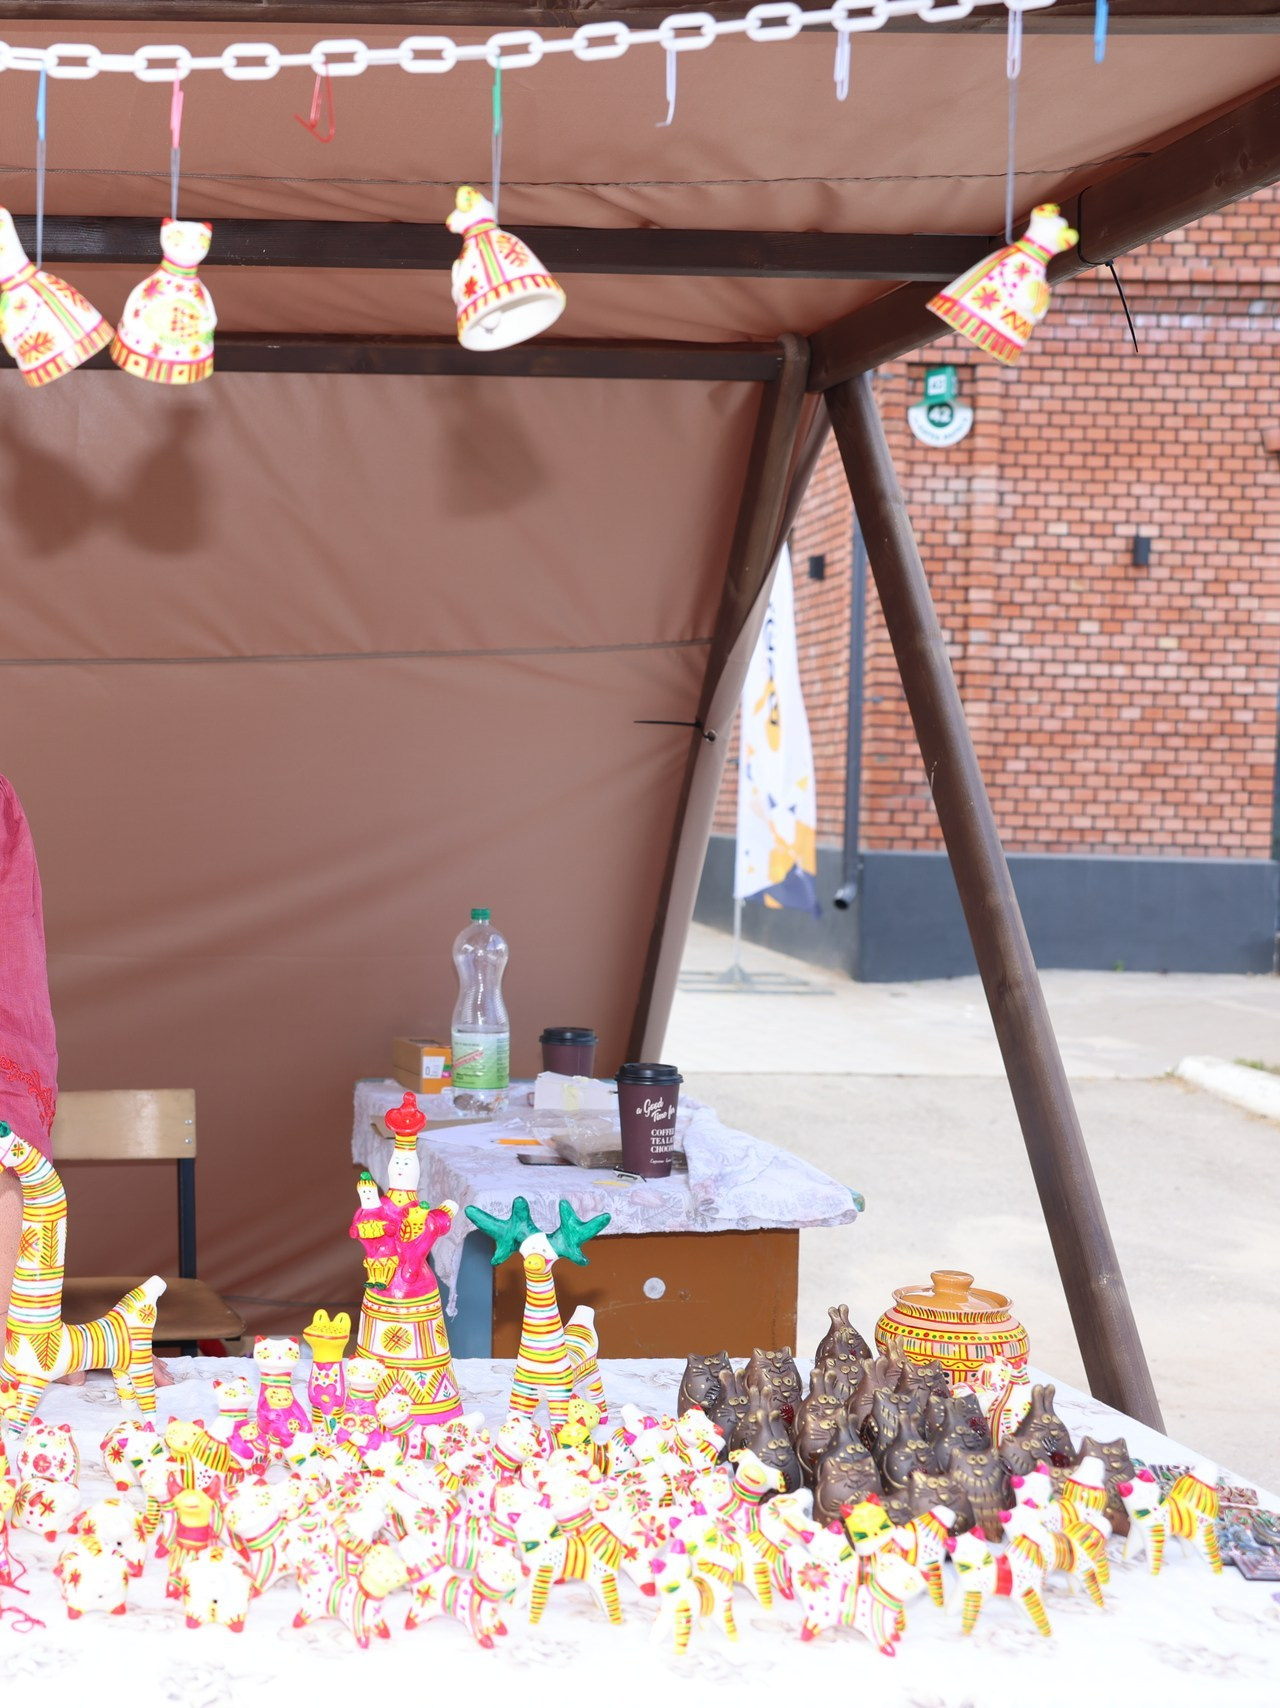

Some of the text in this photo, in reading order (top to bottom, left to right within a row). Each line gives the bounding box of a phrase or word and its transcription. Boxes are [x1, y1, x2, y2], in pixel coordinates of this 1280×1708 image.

[929, 407, 952, 422] 42
[643, 1097, 664, 1117] Good
[651, 1109, 667, 1122] Time
[650, 1136, 665, 1145] TEA
